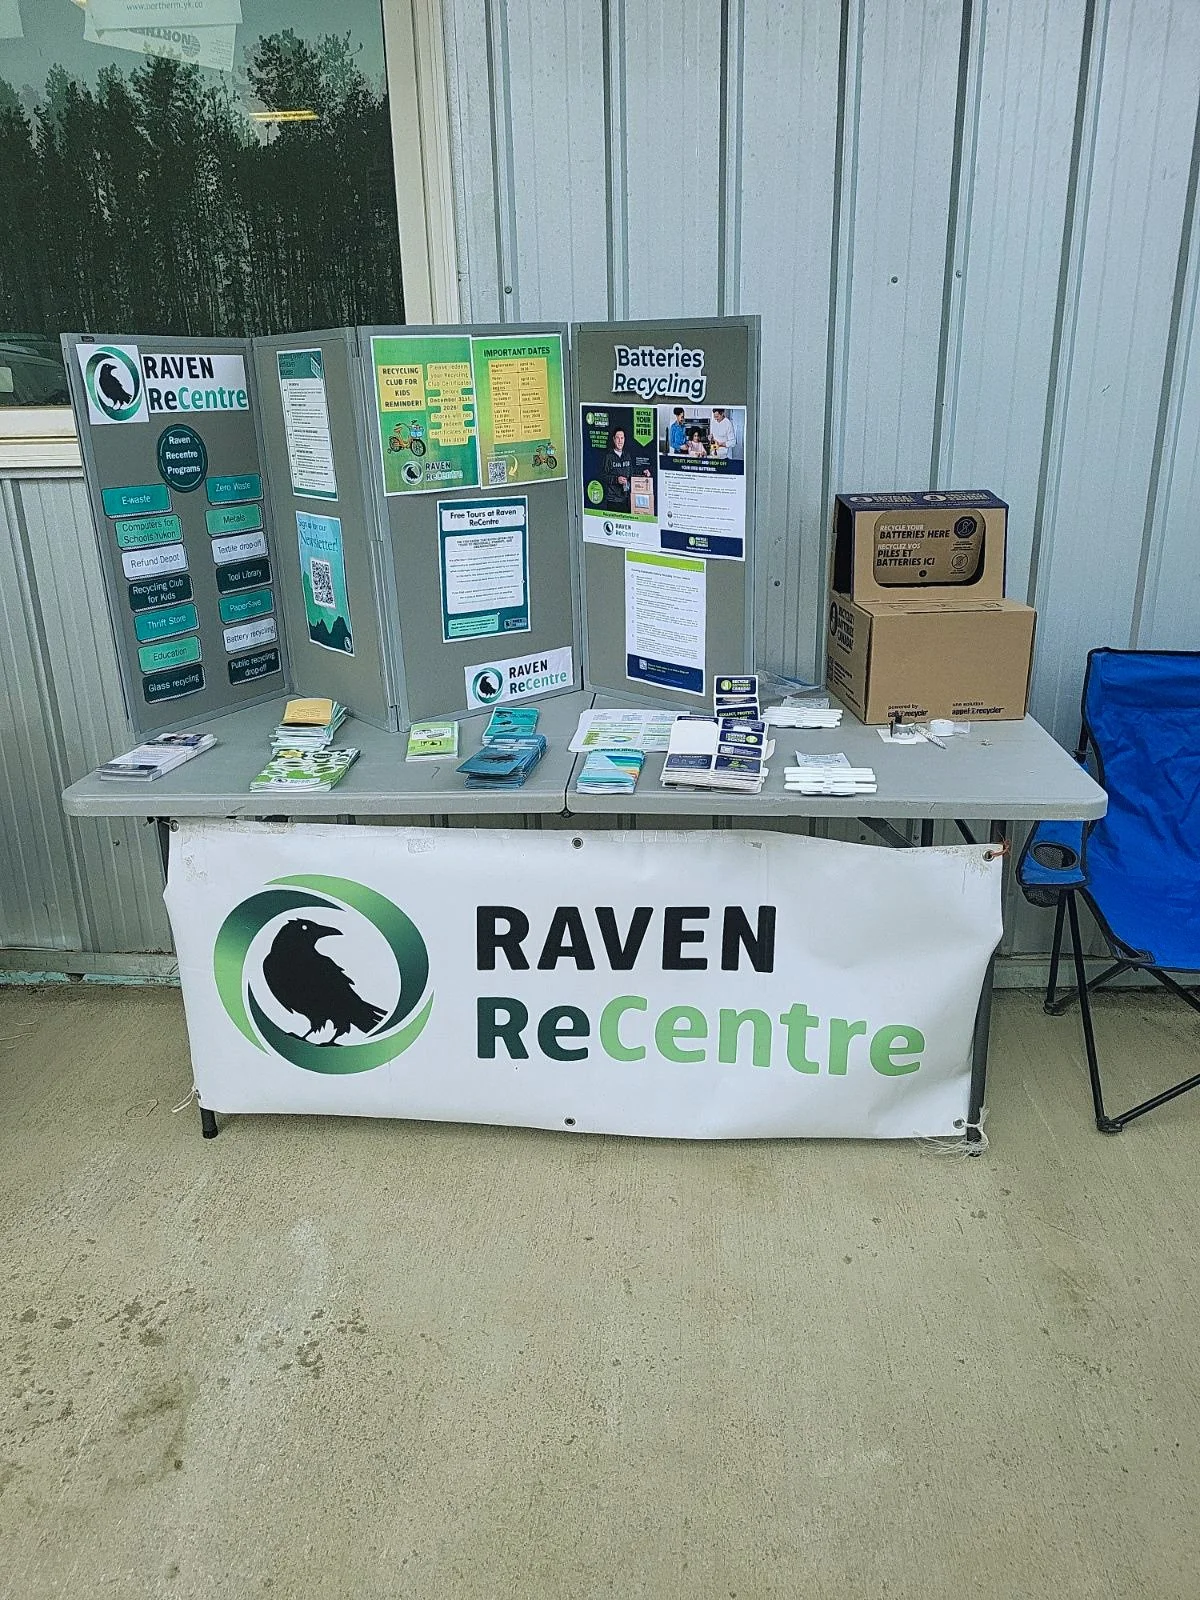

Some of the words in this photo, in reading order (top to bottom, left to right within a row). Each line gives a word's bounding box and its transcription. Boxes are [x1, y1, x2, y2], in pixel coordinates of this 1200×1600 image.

[484, 348, 526, 357] IMPORTANT
[528, 347, 550, 355] DATES
[618, 347, 701, 368] Batteries
[143, 356, 214, 378] RAVEN
[615, 373, 704, 398] Recycling
[148, 387, 248, 410] ReCentre
[169, 436, 190, 444] Raven
[166, 450, 198, 459] Recentre
[167, 465, 200, 476] Programs
[426, 461, 450, 470] RAVEN
[216, 484, 231, 492] Zero
[233, 482, 251, 490] Waste
[122, 495, 151, 504] E-waste
[223, 514, 246, 523] Metals
[122, 521, 162, 532] Computers
[164, 519, 174, 527] for
[124, 534, 153, 544] Schools
[155, 531, 176, 539] Yukon
[880, 531, 925, 539] BATTERIES
[927, 530, 950, 538] HERE
[218, 545, 238, 554] Textile
[131, 557, 158, 568] Refund
[160, 554, 180, 564] Depot
[877, 558, 921, 566] BATTERIES
[228, 573, 240, 581] Tool
[242, 570, 262, 579] Library
[133, 582, 167, 595] Recycling
[168, 579, 184, 588] Club
[148, 596, 158, 604] for
[161, 592, 176, 601] Kids
[148, 618, 166, 629] Thrift
[169, 614, 186, 625] Store
[226, 633, 249, 643] Battery
[154, 647, 187, 661] Education
[231, 659, 250, 669] Public
[509, 659, 548, 679] RAVEN
[148, 681, 170, 692] Glass
[172, 674, 199, 687] recycling
[510, 672, 567, 694] ReCentre
[477, 905, 776, 974] RAVEN
[477, 996, 926, 1076] ReCentre
